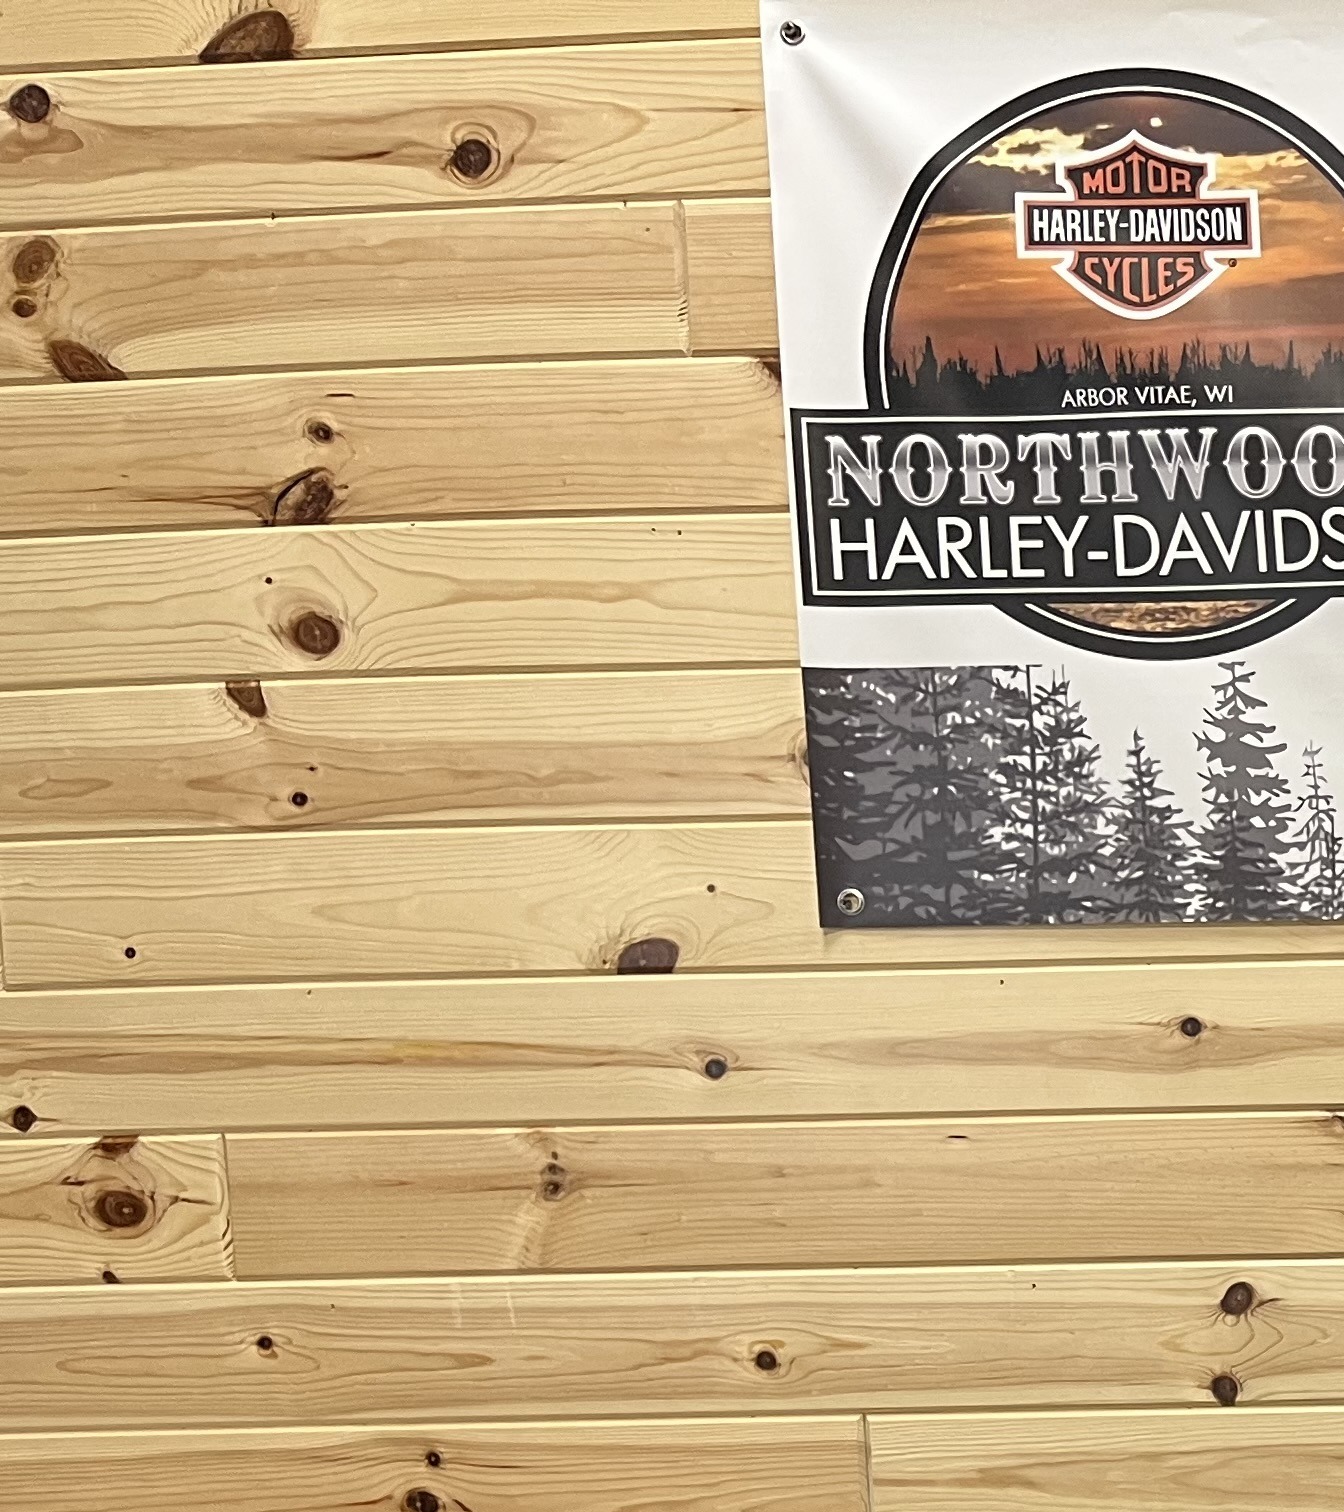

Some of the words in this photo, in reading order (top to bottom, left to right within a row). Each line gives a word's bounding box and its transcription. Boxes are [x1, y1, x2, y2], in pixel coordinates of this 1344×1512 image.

[1082, 151, 1192, 195] MOTOR
[1032, 206, 1243, 243] HARLEY-DAVIDSON
[1084, 257, 1195, 304] CYCLES
[1061, 386, 1129, 408] ARBOR
[1134, 385, 1197, 408] VITAE,
[1203, 384, 1233, 403] WI
